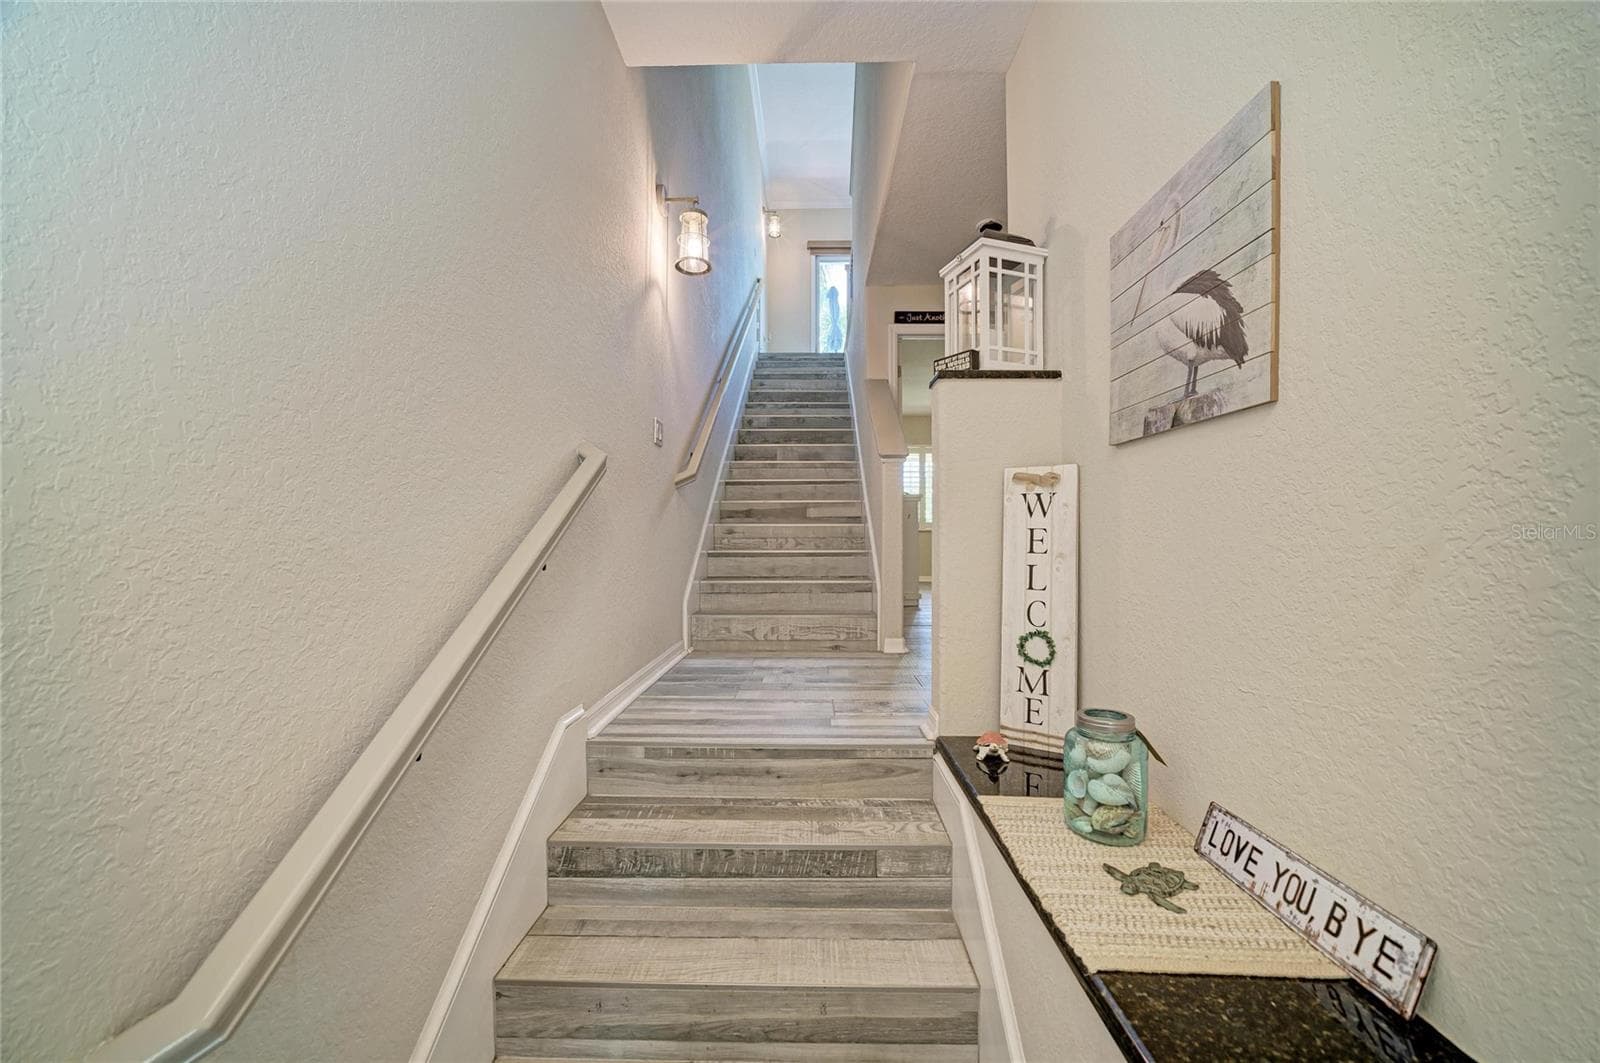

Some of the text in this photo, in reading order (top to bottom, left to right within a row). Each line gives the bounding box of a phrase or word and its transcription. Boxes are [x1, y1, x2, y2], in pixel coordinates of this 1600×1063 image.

[906, 312, 922, 323] Just
[947, 357, 970, 368] WOULD
[1016, 492, 1057, 727] WELCOME
[1208, 820, 1404, 981] LOVE YOU, BYE
